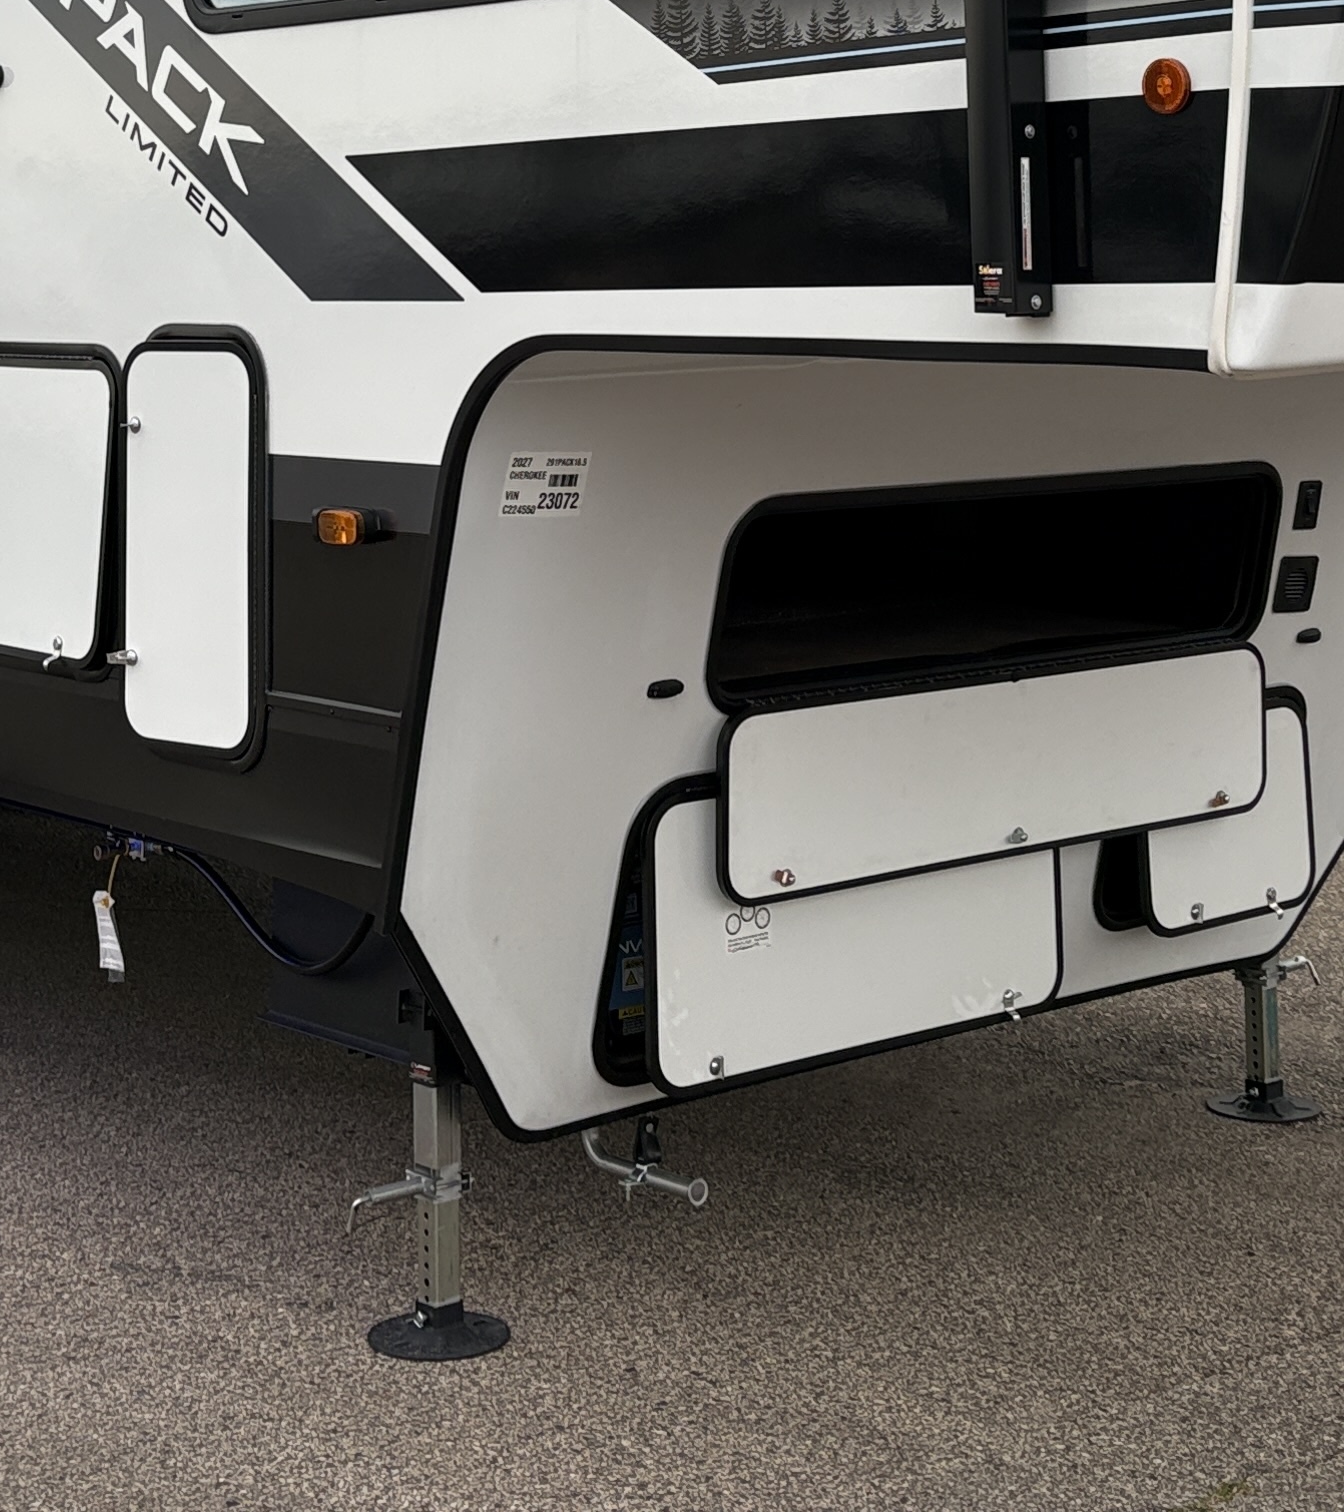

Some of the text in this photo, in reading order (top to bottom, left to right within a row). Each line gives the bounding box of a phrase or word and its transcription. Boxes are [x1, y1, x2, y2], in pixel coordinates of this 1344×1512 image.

[103, 94, 230, 239] LIMITED
[512, 457, 533, 467] 2027
[509, 470, 547, 480] CHEROKEE
[505, 490, 580, 510] VIN 23072
